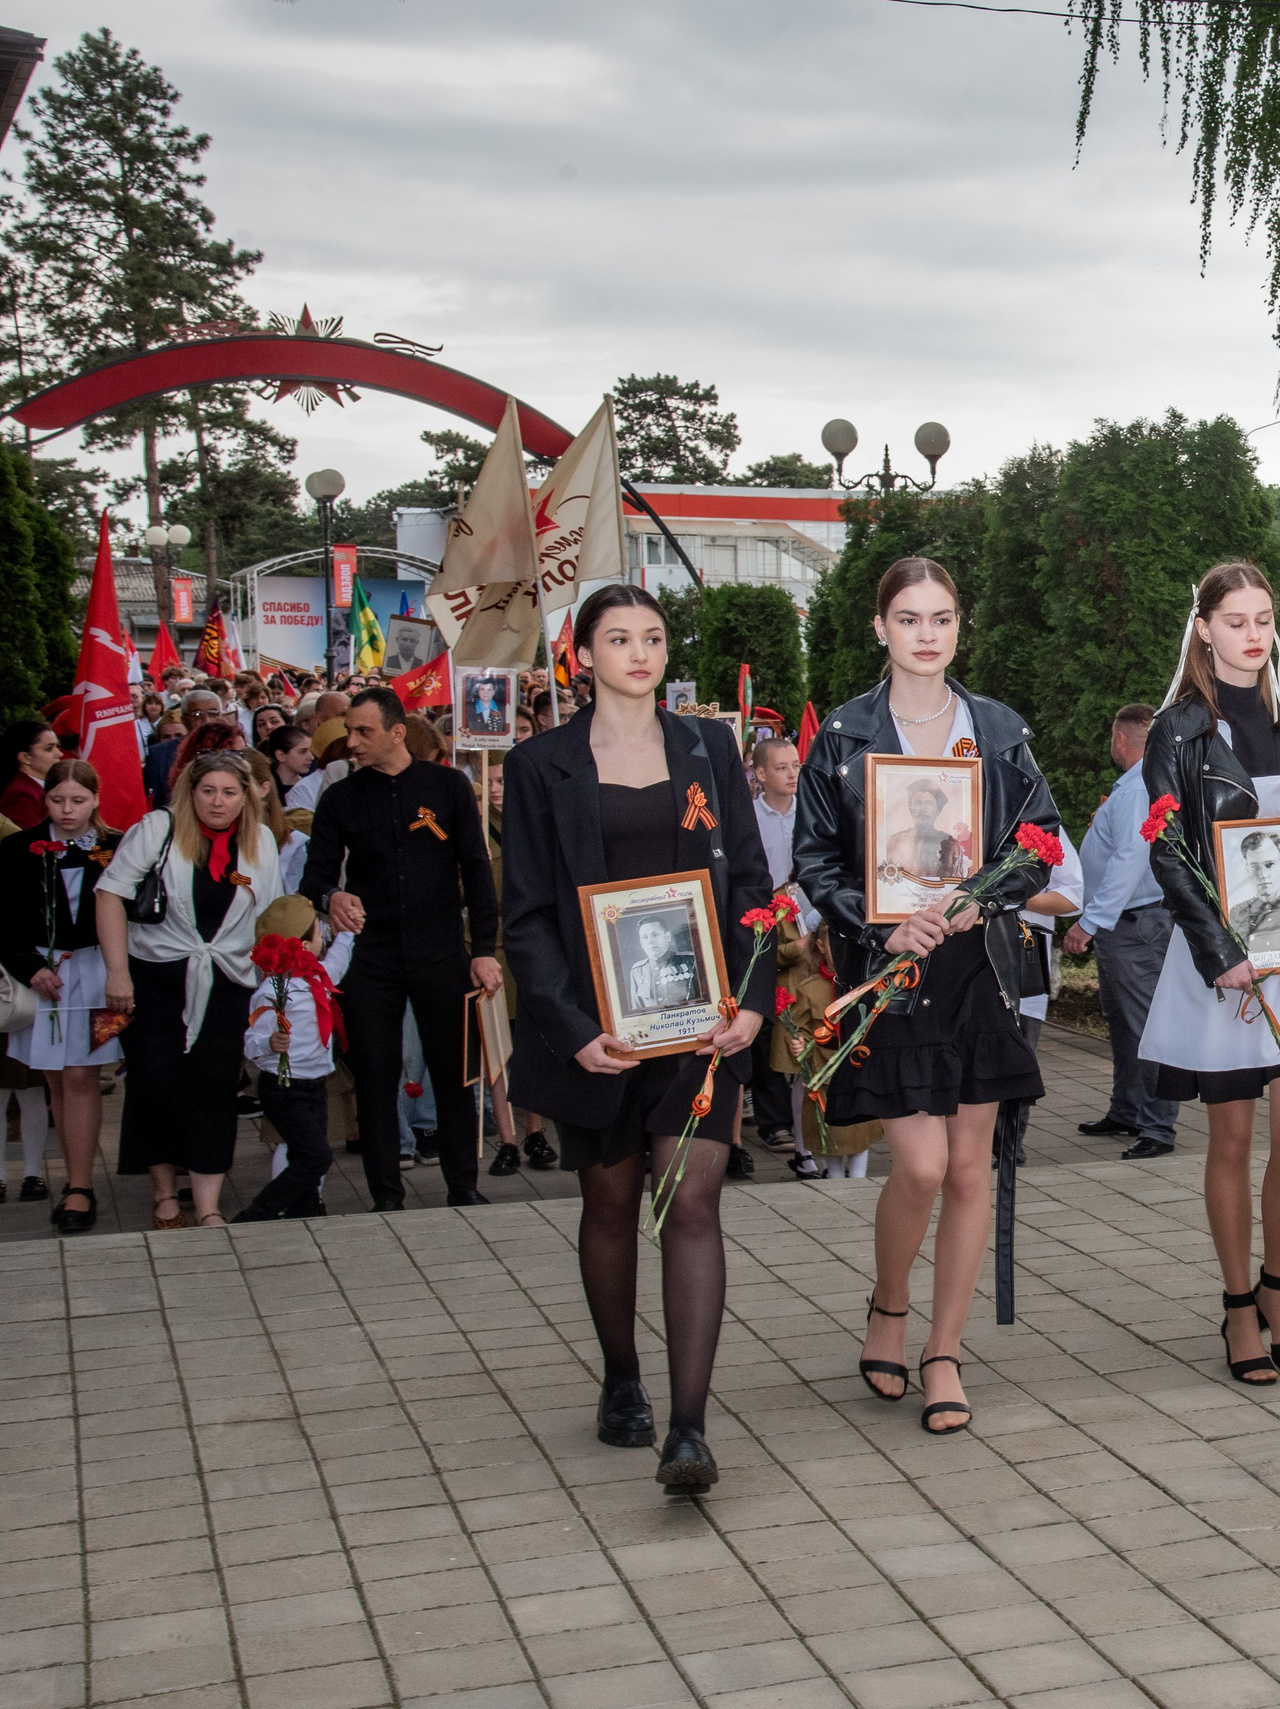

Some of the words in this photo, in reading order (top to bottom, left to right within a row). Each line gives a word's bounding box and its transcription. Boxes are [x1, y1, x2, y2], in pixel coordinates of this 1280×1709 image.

[262, 602, 310, 613] СПАСИБО
[263, 615, 277, 625] ЗА
[280, 616, 324, 627] ПОБЕДУ!
[660, 1008, 706, 1020] Панкратов
[650, 1019, 684, 1031] Николай
[686, 1015, 720, 1027] Кузьмич
[677, 1027, 696, 1035] 1911
